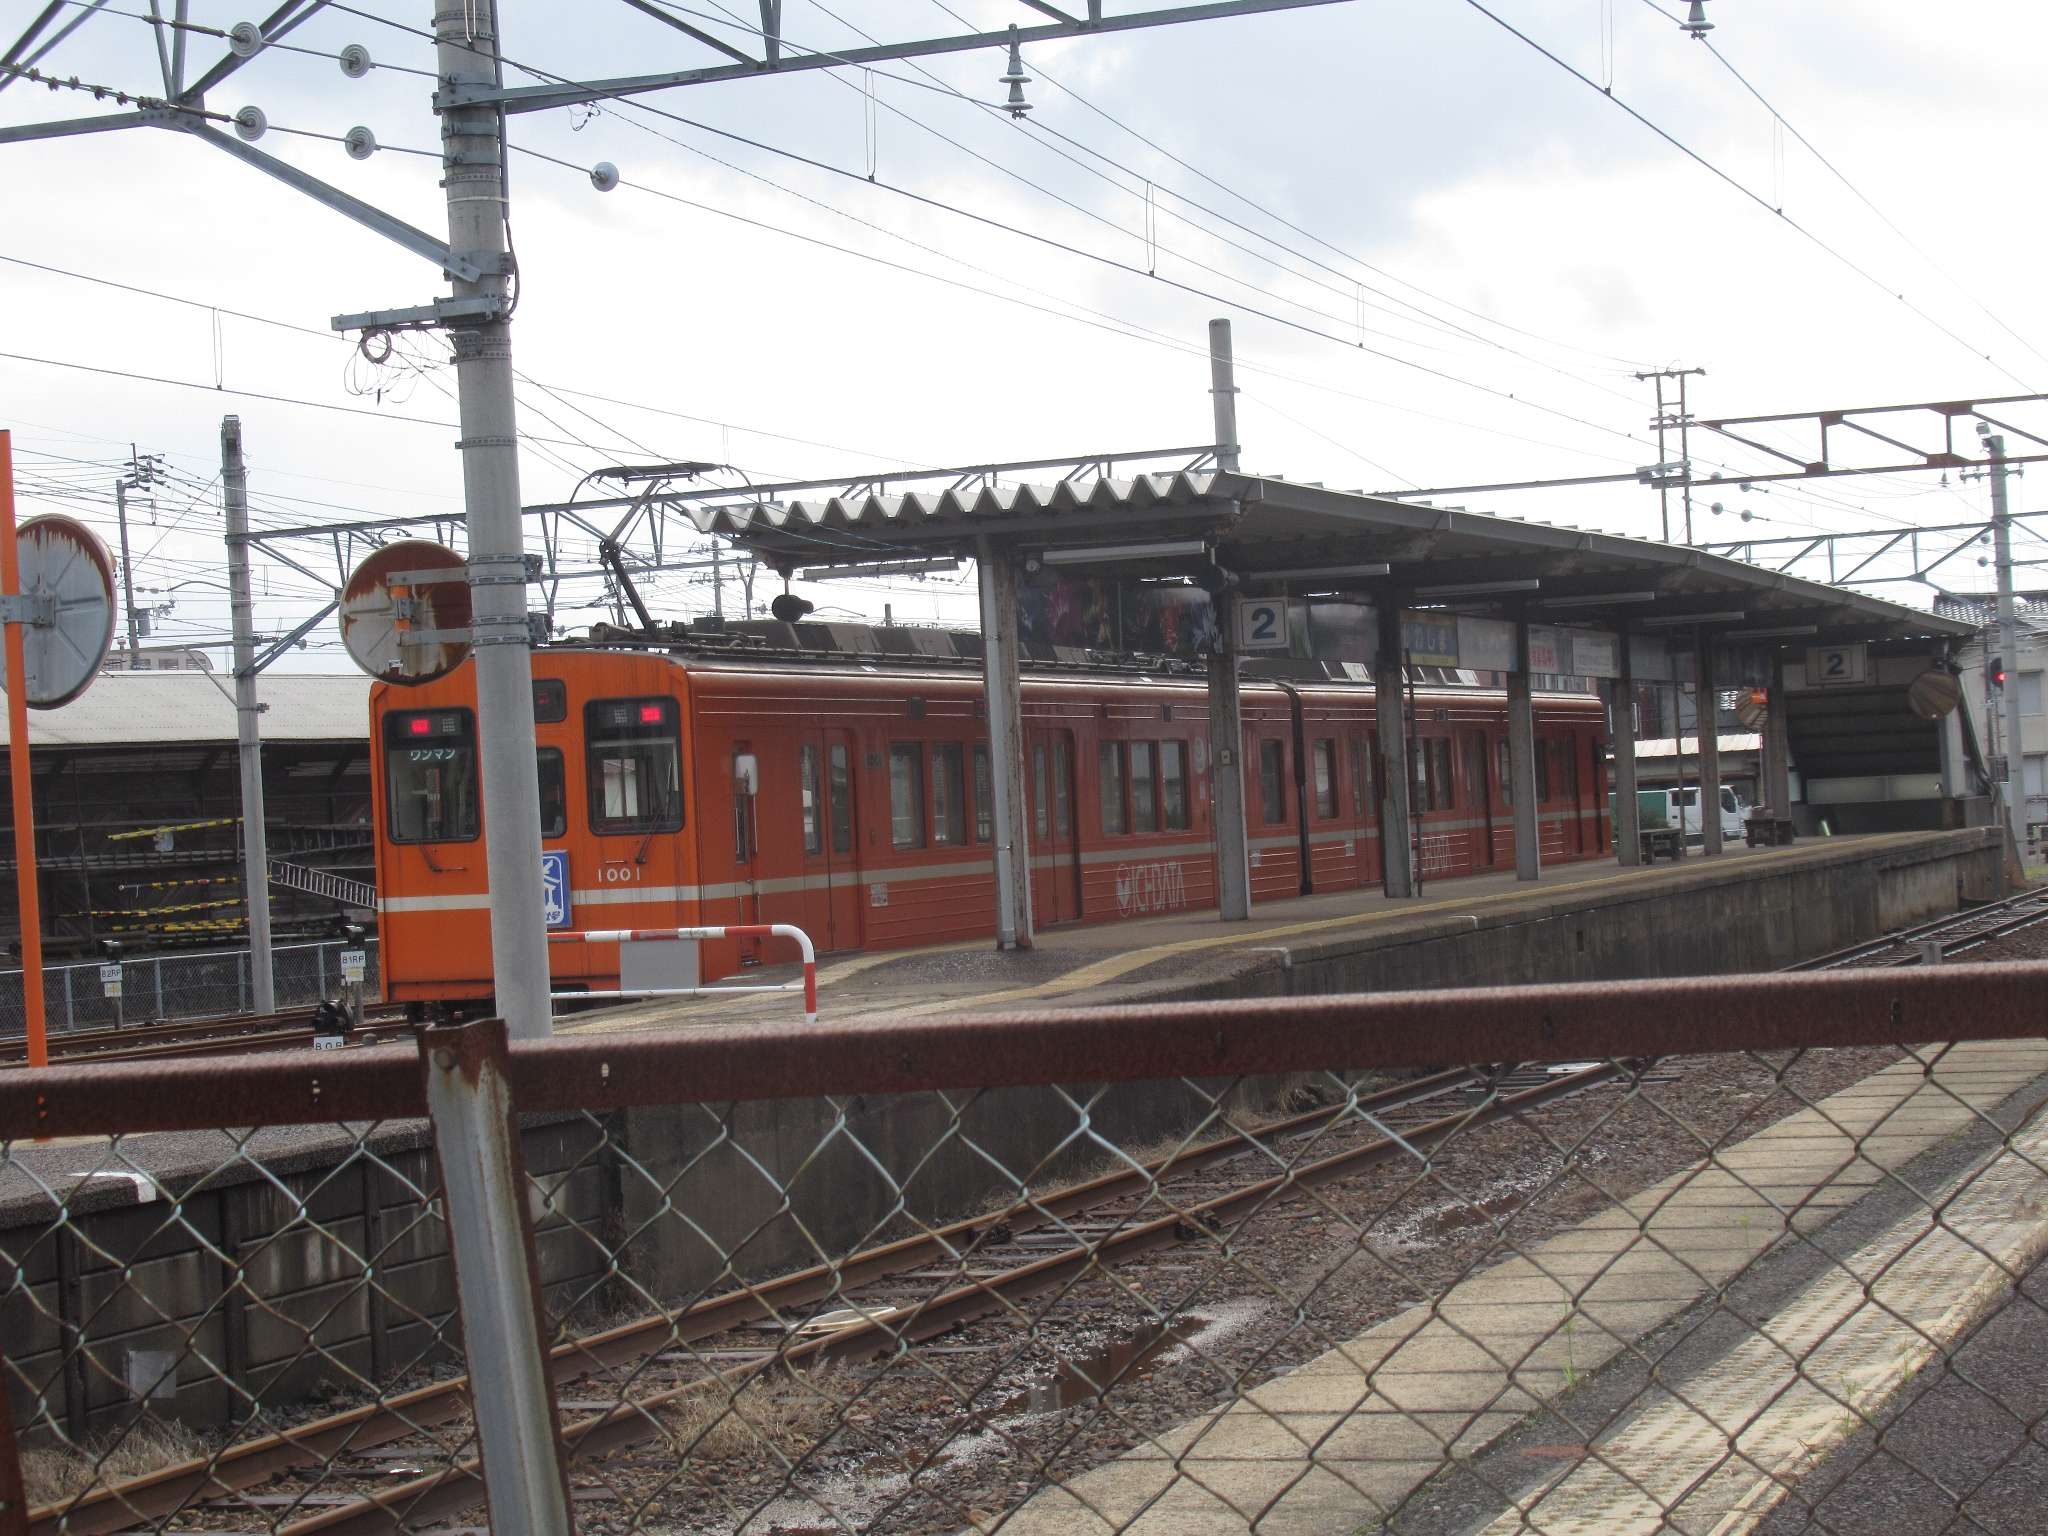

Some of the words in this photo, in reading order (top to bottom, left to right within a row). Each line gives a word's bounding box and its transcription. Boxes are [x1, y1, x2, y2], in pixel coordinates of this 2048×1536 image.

[1251, 608, 1277, 639] 2
[1826, 653, 1845, 675] 2
[410, 748, 456, 760] ワンマン
[598, 866, 640, 882] 1001
